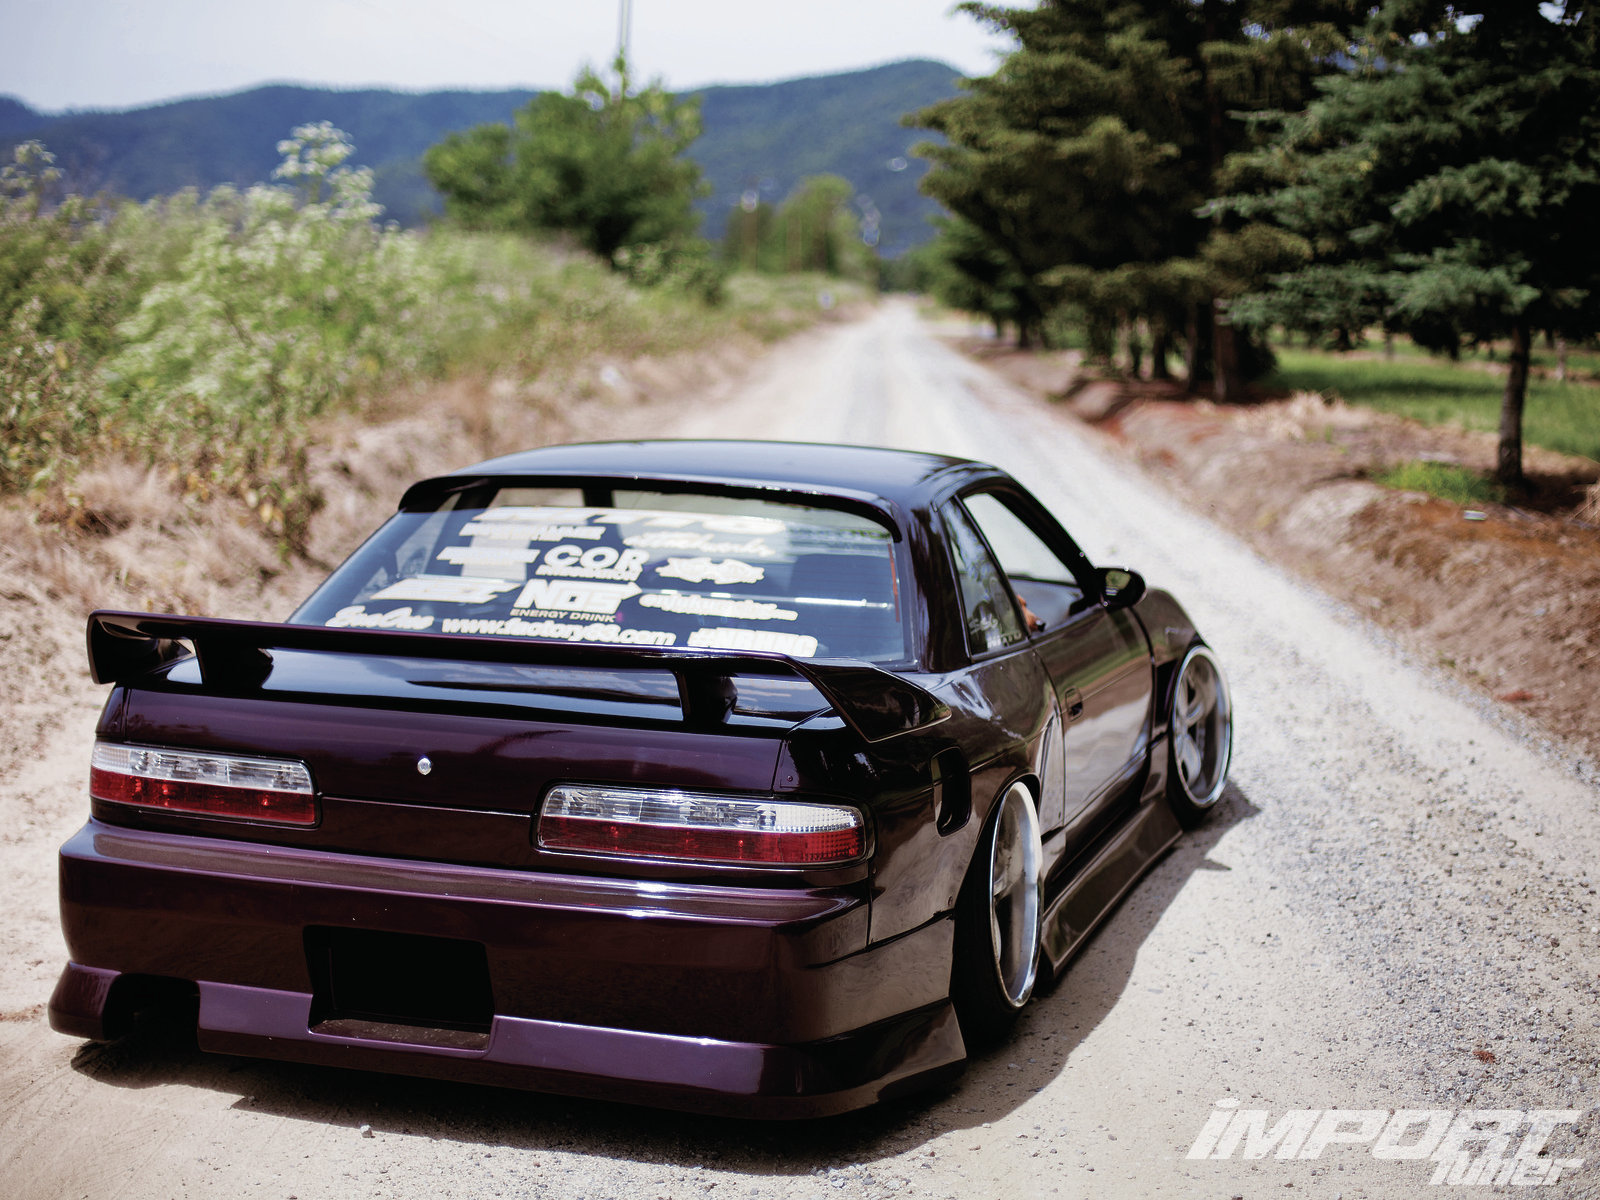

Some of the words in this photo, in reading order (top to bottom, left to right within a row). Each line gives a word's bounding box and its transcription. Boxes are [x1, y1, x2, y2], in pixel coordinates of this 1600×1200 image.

[544, 544, 650, 574] COR
[513, 578, 642, 614] NOS
[510, 608, 569, 619] ENERGY
[570, 611, 616, 623] DRINK
